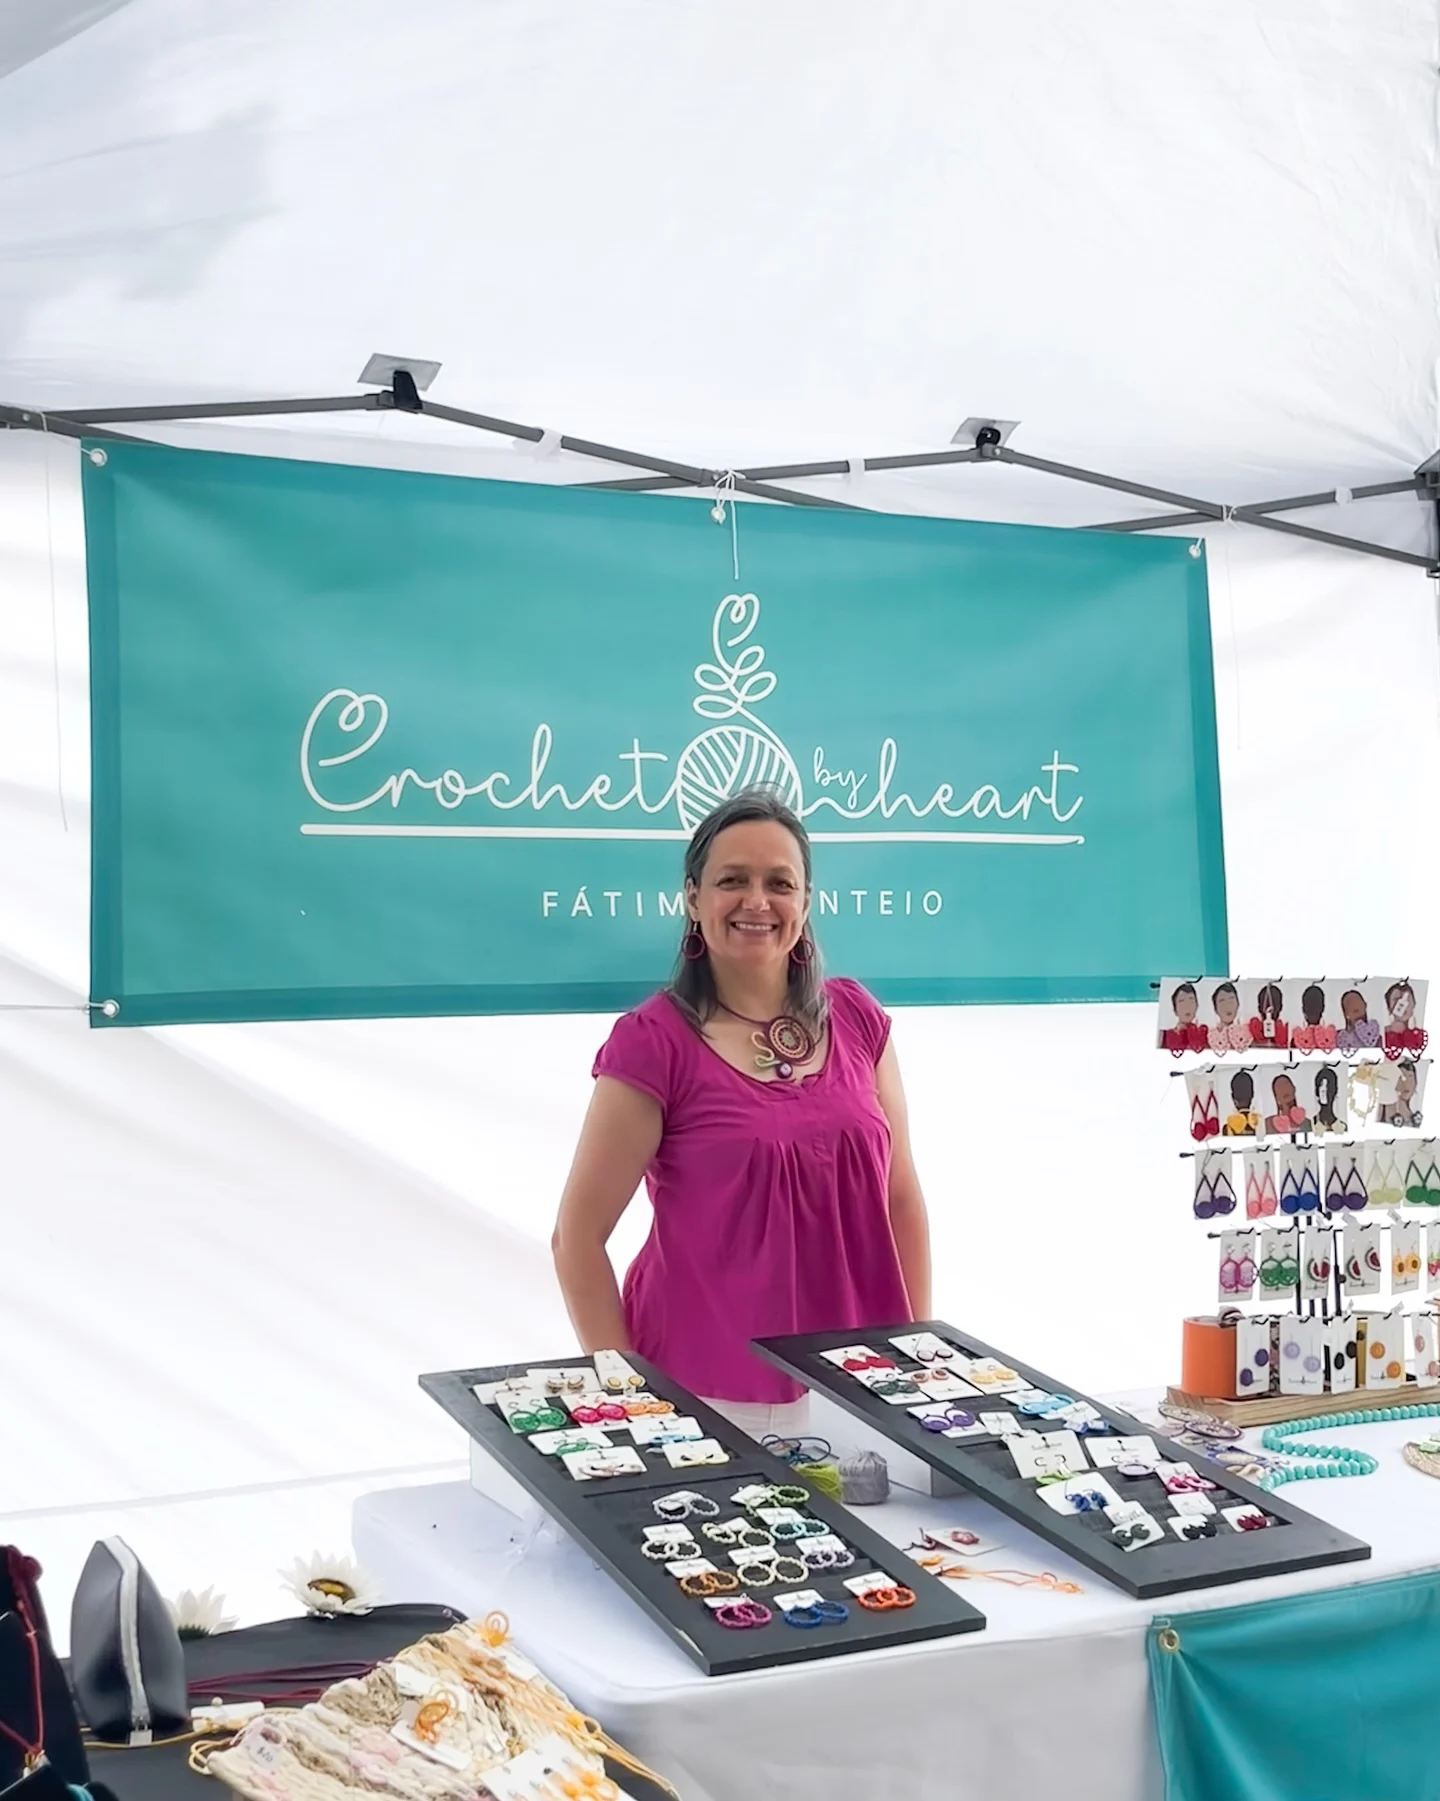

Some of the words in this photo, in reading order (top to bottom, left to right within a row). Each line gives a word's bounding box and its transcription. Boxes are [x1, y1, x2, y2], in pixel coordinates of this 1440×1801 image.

[301, 688, 680, 813] Crochet
[813, 746, 867, 810] by
[848, 737, 1083, 823] heart
[543, 886, 686, 917] FÁTIM
[819, 889, 943, 916] NTEIO
